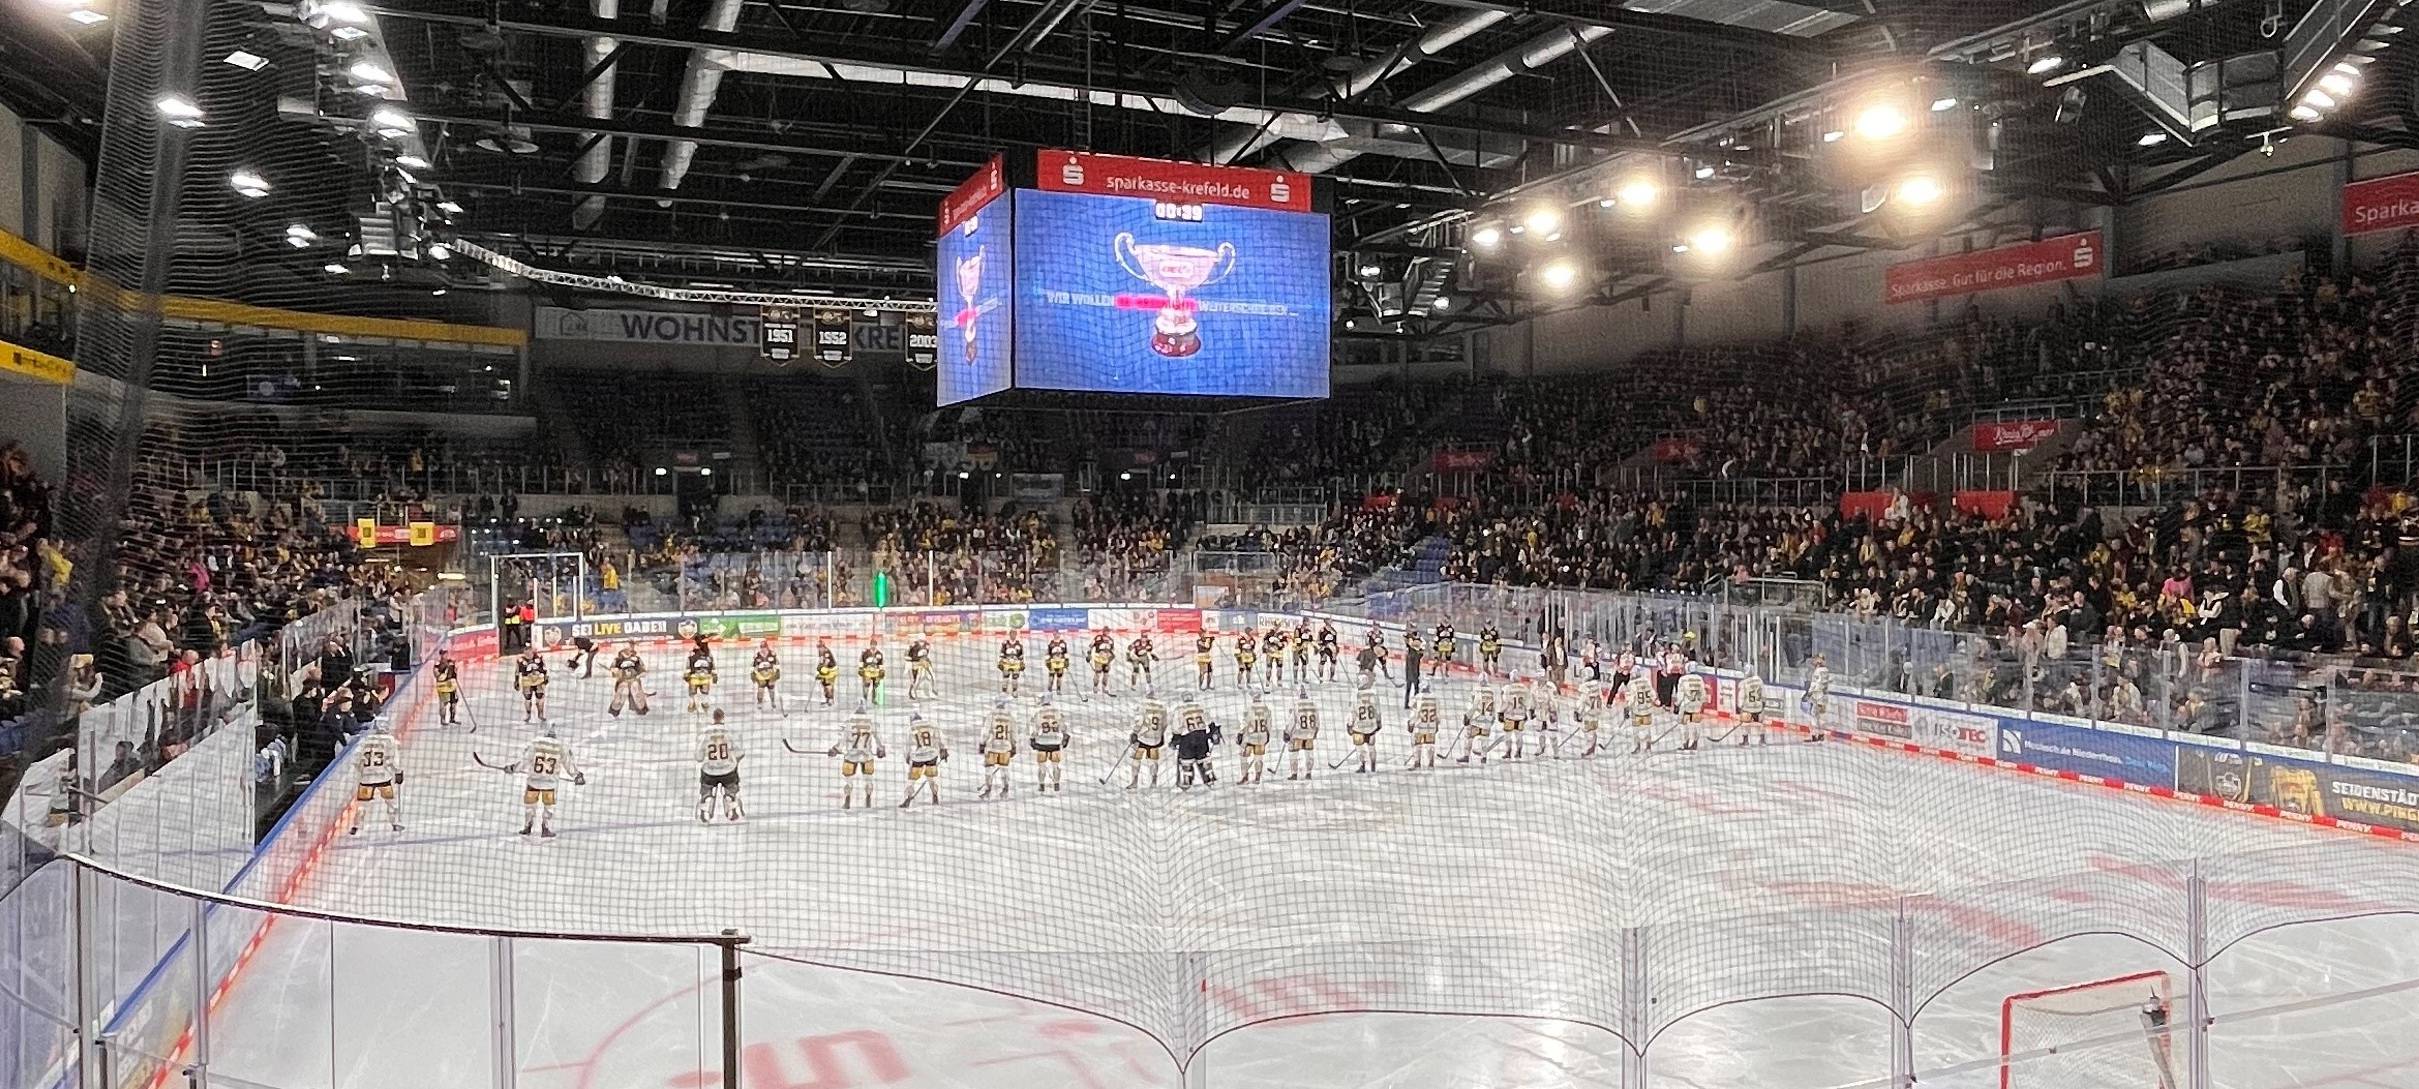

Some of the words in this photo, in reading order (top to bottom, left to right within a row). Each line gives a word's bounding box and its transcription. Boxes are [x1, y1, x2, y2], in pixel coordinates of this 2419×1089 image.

[1106, 175, 1250, 199] sparkasse-krefeld.de
[2355, 198, 2419, 225] Sparka
[1952, 273, 1974, 287] Gut
[767, 329, 794, 343] 1951
[818, 331, 847, 345] 1952
[909, 334, 937, 348] 2003
[594, 622, 621, 636] LIVE
[1358, 705, 1376, 721] 28
[1421, 708, 1437, 723] 32
[914, 731, 932, 748] 18
[995, 724, 1009, 740] 21
[851, 732, 871, 749] 77
[707, 743, 729, 761] 20
[533, 755, 557, 775] 63
